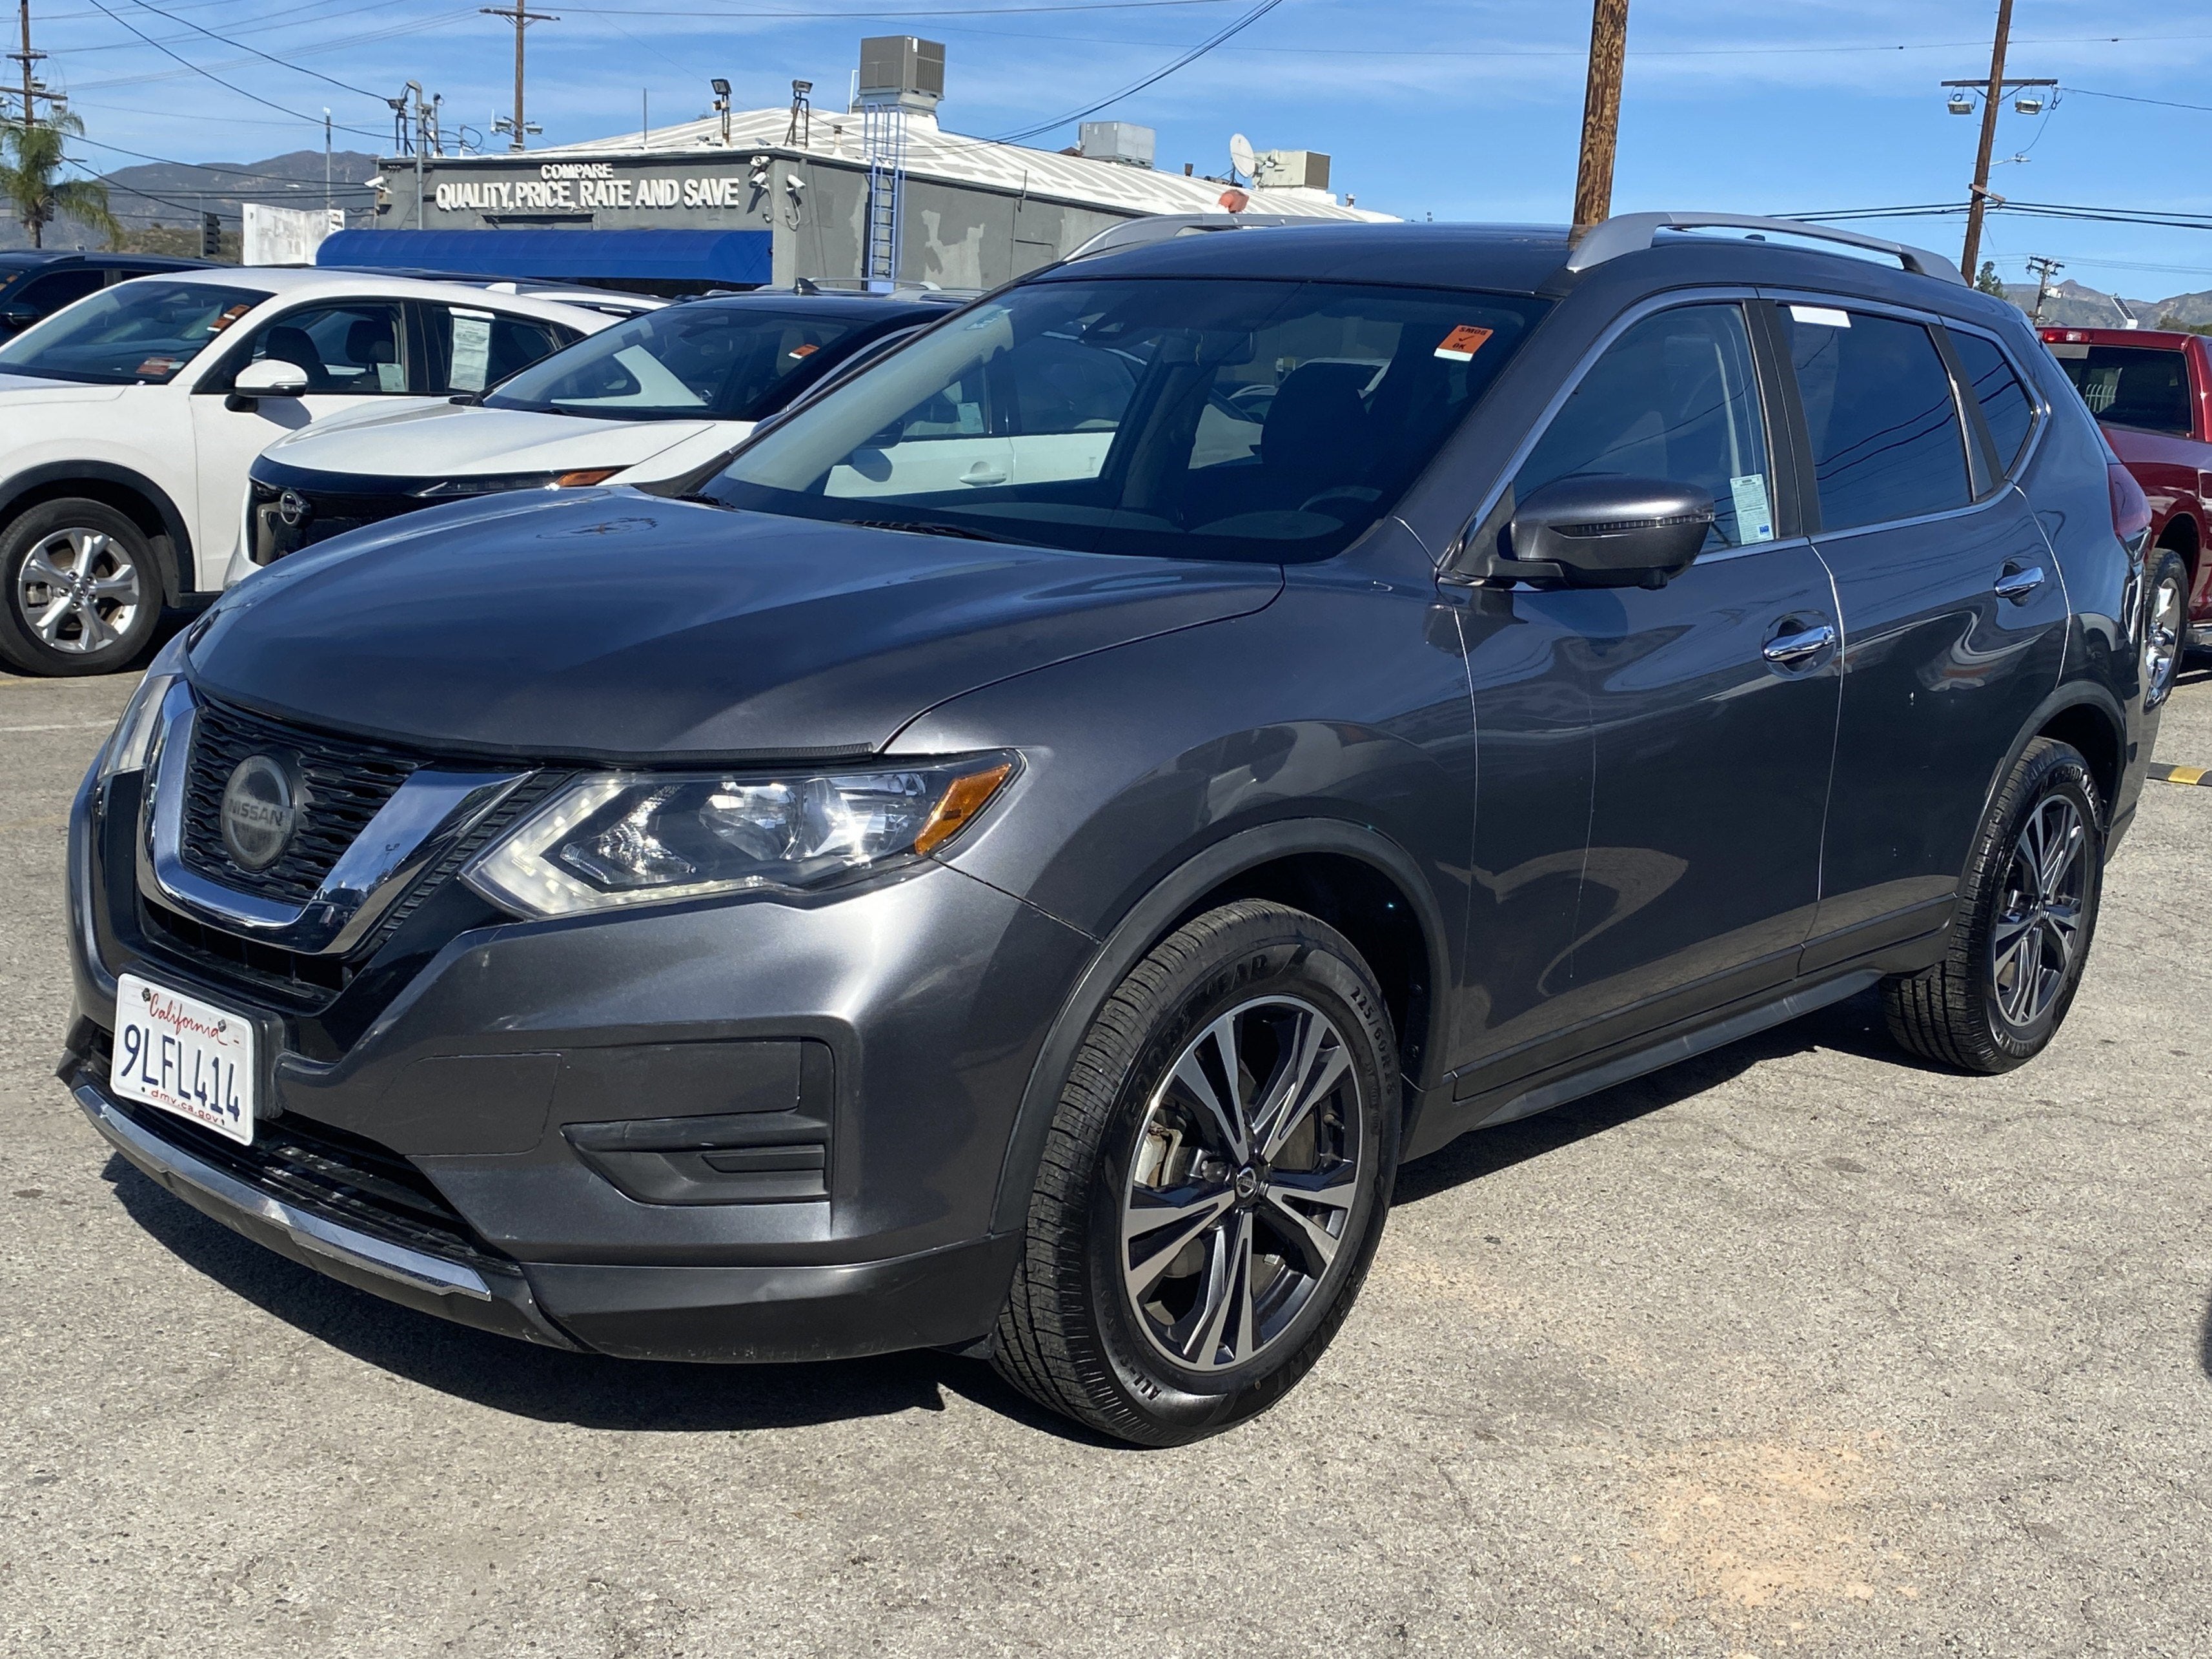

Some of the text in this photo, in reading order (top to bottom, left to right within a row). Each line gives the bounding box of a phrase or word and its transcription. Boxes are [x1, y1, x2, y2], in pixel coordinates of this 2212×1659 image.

[541, 163, 613, 179] COMPARE
[436, 182, 514, 212] QUALITY,
[580, 179, 631, 209] RATE
[635, 179, 680, 207] AND
[684, 178, 739, 207] SAVE
[228, 798, 284, 826] NISSAN
[149, 993, 228, 1046] California
[121, 1024, 240, 1122] 9LFL414
[150, 1090, 219, 1123] dmv.ca.gov
